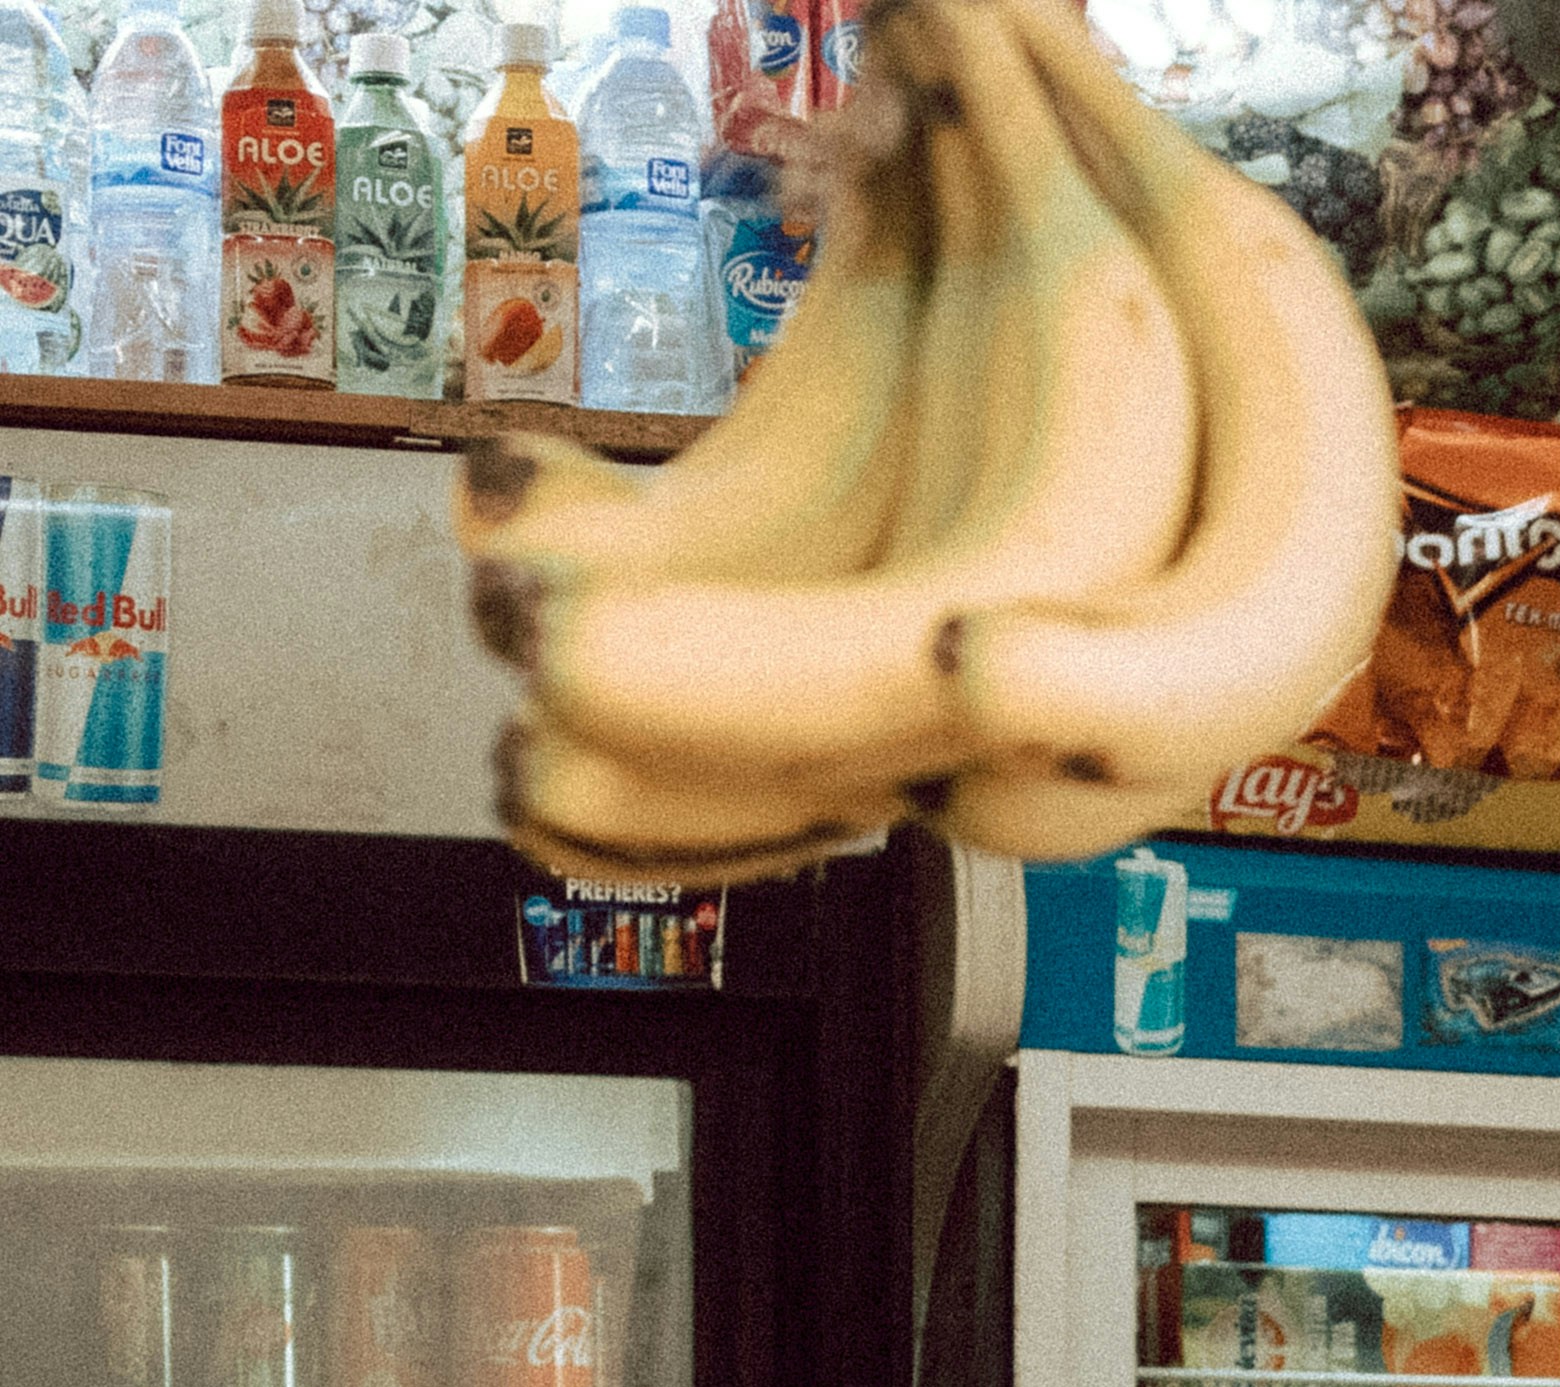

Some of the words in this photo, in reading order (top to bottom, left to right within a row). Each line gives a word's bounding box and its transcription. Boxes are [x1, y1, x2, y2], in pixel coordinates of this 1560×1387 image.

[238, 137, 324, 166] ALOE
[353, 177, 432, 208] ALOE
[480, 165, 559, 192] ALOE
[0, 211, 56, 247] QUA
[112, 594, 167, 632] Bull
[565, 879, 682, 904] PREFIERES?
